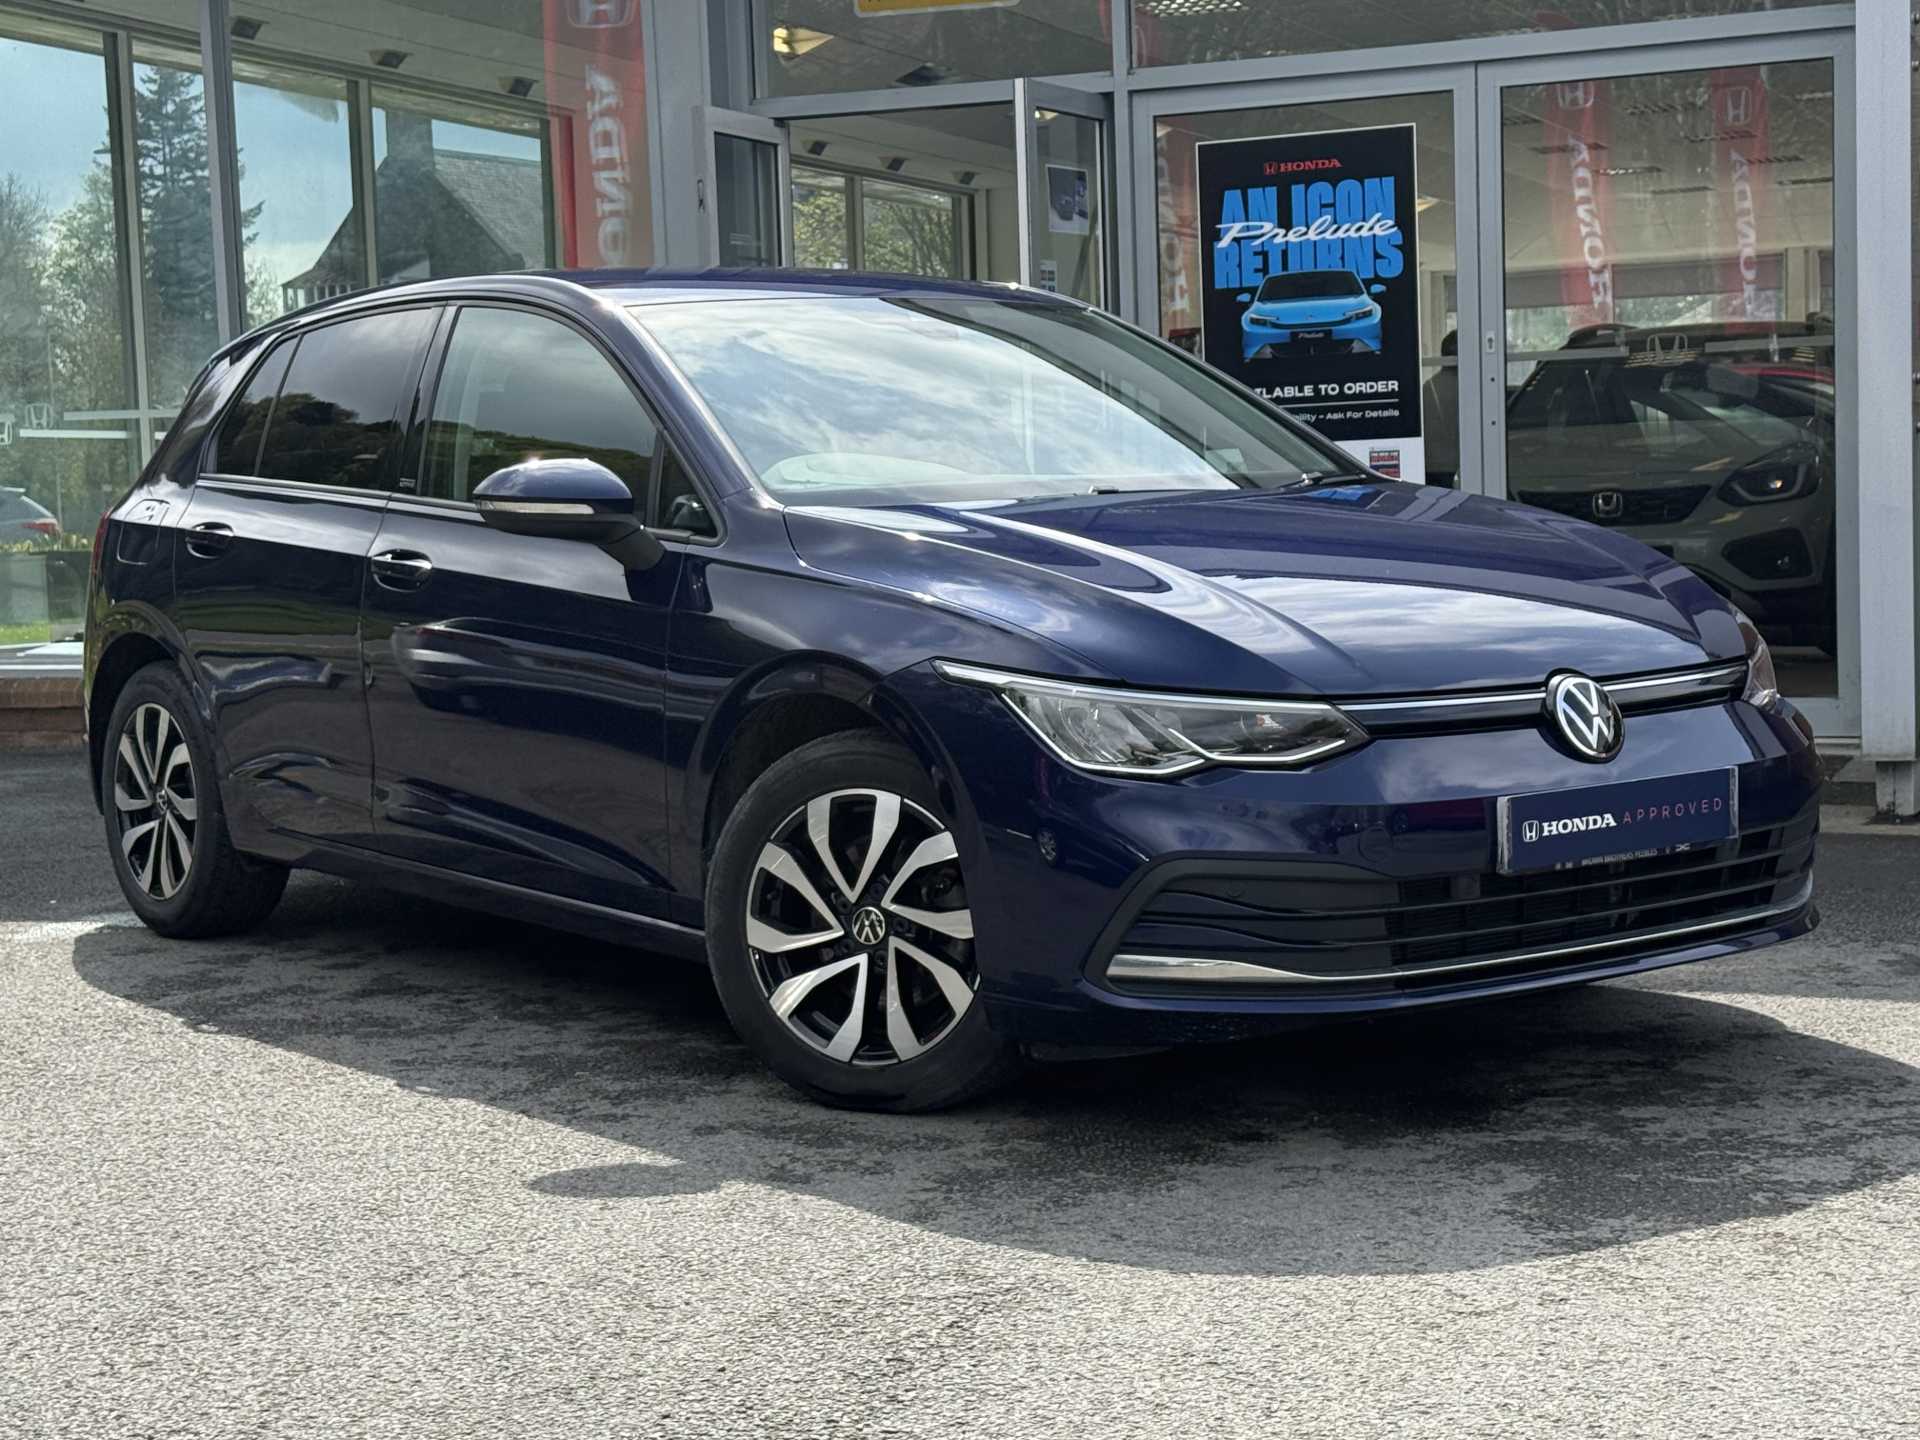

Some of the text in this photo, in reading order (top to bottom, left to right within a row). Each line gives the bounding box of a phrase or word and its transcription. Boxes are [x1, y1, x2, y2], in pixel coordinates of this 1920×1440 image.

[1280, 159, 1342, 172] HONDA
[1220, 176, 1396, 238] AN ICON
[1215, 212, 1398, 248] Prelude
[1213, 230, 1404, 289] RETURNS
[1319, 384, 1340, 396] TO
[1344, 380, 1399, 394] ORDER
[1326, 412, 1345, 420] Ask
[1346, 411, 1363, 419] For
[1542, 813, 1617, 837] HONDA
[1622, 798, 1723, 825] APPROVED
